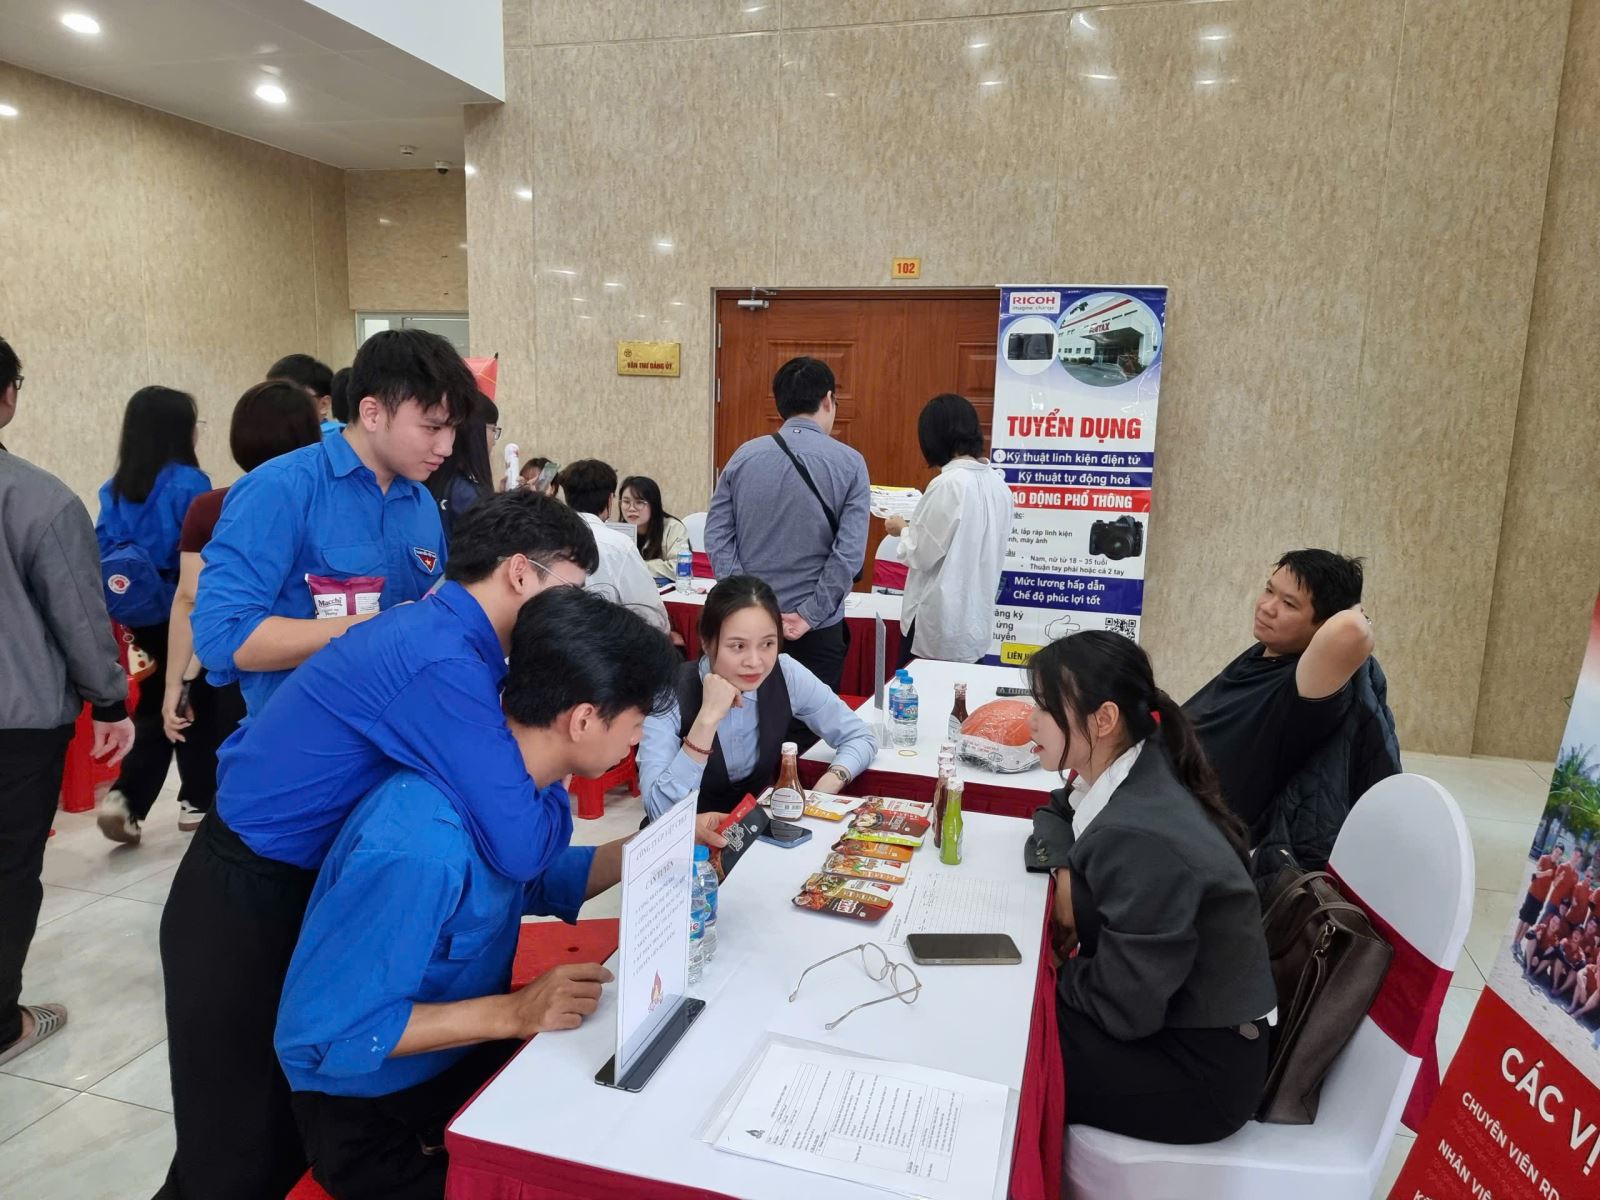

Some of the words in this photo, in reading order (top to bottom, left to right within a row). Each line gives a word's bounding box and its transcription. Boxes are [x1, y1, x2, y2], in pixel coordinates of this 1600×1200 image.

[896, 262, 915, 274] 102
[1012, 296, 1056, 305] RICOH
[1007, 408, 1075, 438] TUYỂN
[1080, 417, 1142, 443] DỤNG
[1006, 451, 1021, 464] Kỹ
[1023, 452, 1050, 465] thuật
[1052, 453, 1072, 463] linh
[1075, 453, 1098, 466] kiện
[1101, 454, 1124, 467] điện
[1128, 454, 1141, 465] tử
[1018, 471, 1032, 484] Kỹ
[1034, 472, 1062, 485] thuật
[1064, 473, 1077, 485] tự
[1079, 473, 1107, 487] động
[1110, 474, 1131, 485] hoá
[1012, 492, 1026, 505] AO
[1029, 490, 1061, 508] ĐỘNG
[1064, 490, 1090, 506] PHỔ
[1092, 493, 1133, 509] THÔNG
[1014, 576, 1036, 587] Mức
[1037, 577, 1066, 591] lương
[1067, 578, 1085, 592] hấp
[1087, 579, 1105, 591] dẫn
[1013, 588, 1031, 600] Chế
[1032, 591, 1045, 603] độ
[1046, 592, 1069, 604] phúc
[1071, 594, 1084, 605] lợi
[1086, 593, 1101, 605] tốt
[994, 608, 1011, 620] ăng
[1013, 610, 1024, 620] ký
[1007, 650, 1023, 660] LIÊN
[1501, 1047, 1564, 1124] CÁC
[1569, 1108, 1600, 1176] VỊ
[1462, 1091, 1508, 1149] CHUYÊN
[1509, 1141, 1539, 1184] VIÊN
[1438, 1138, 1471, 1184] NHÂN
[1472, 1177, 1492, 1200] VIÊ
